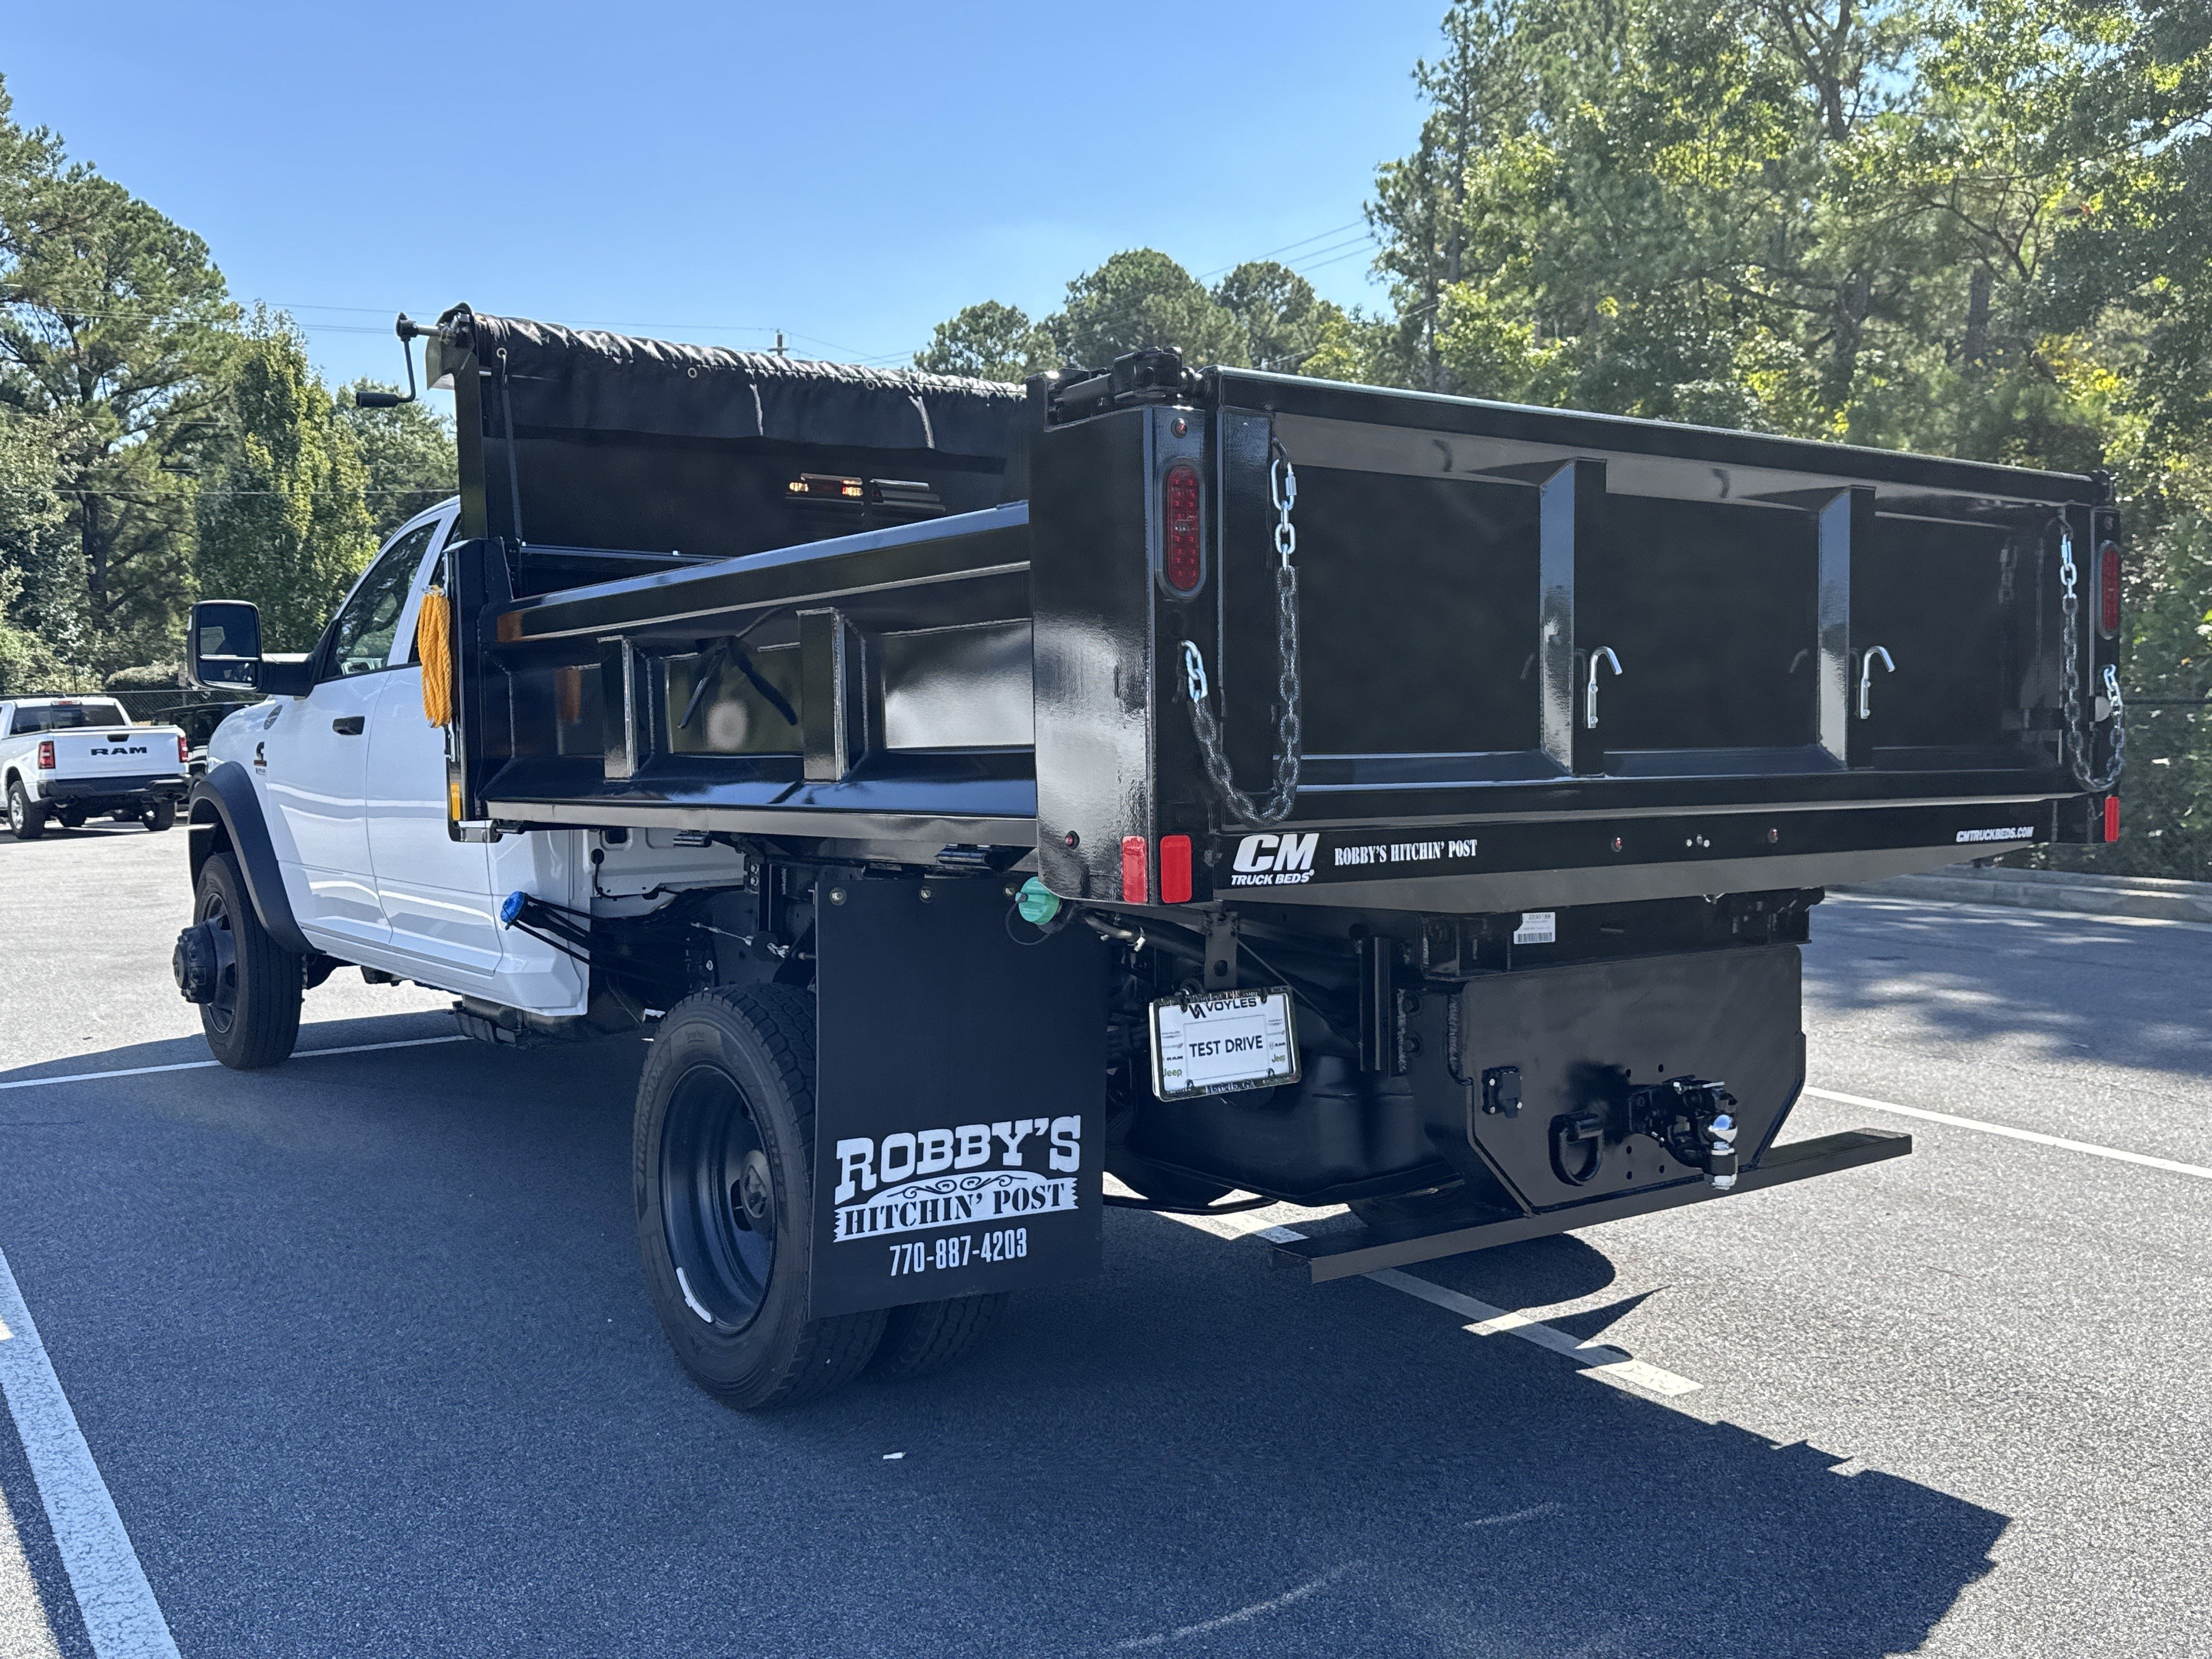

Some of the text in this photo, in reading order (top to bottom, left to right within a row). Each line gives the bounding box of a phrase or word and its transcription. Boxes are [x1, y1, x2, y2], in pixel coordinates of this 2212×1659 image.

[91, 747, 147, 755] RAM
[1956, 826, 2034, 842] CMTRUCKBEDS.COM
[1233, 833, 1319, 872] CM
[1334, 839, 1477, 866] ROBBY'S HITCHIN' POST
[1231, 874, 1272, 885] TRUCK
[1207, 998, 1257, 1012] VOYLES
[1189, 1035, 1263, 1057] TEST DRIVE
[1272, 1054, 1285, 1063] Jeep
[1163, 1068, 1182, 1077] Jeep
[834, 1115, 1081, 1205] ROBBY'S
[844, 1183, 1064, 1235] HITCHIN' POST
[889, 1227, 1028, 1276] 770-887-4203
